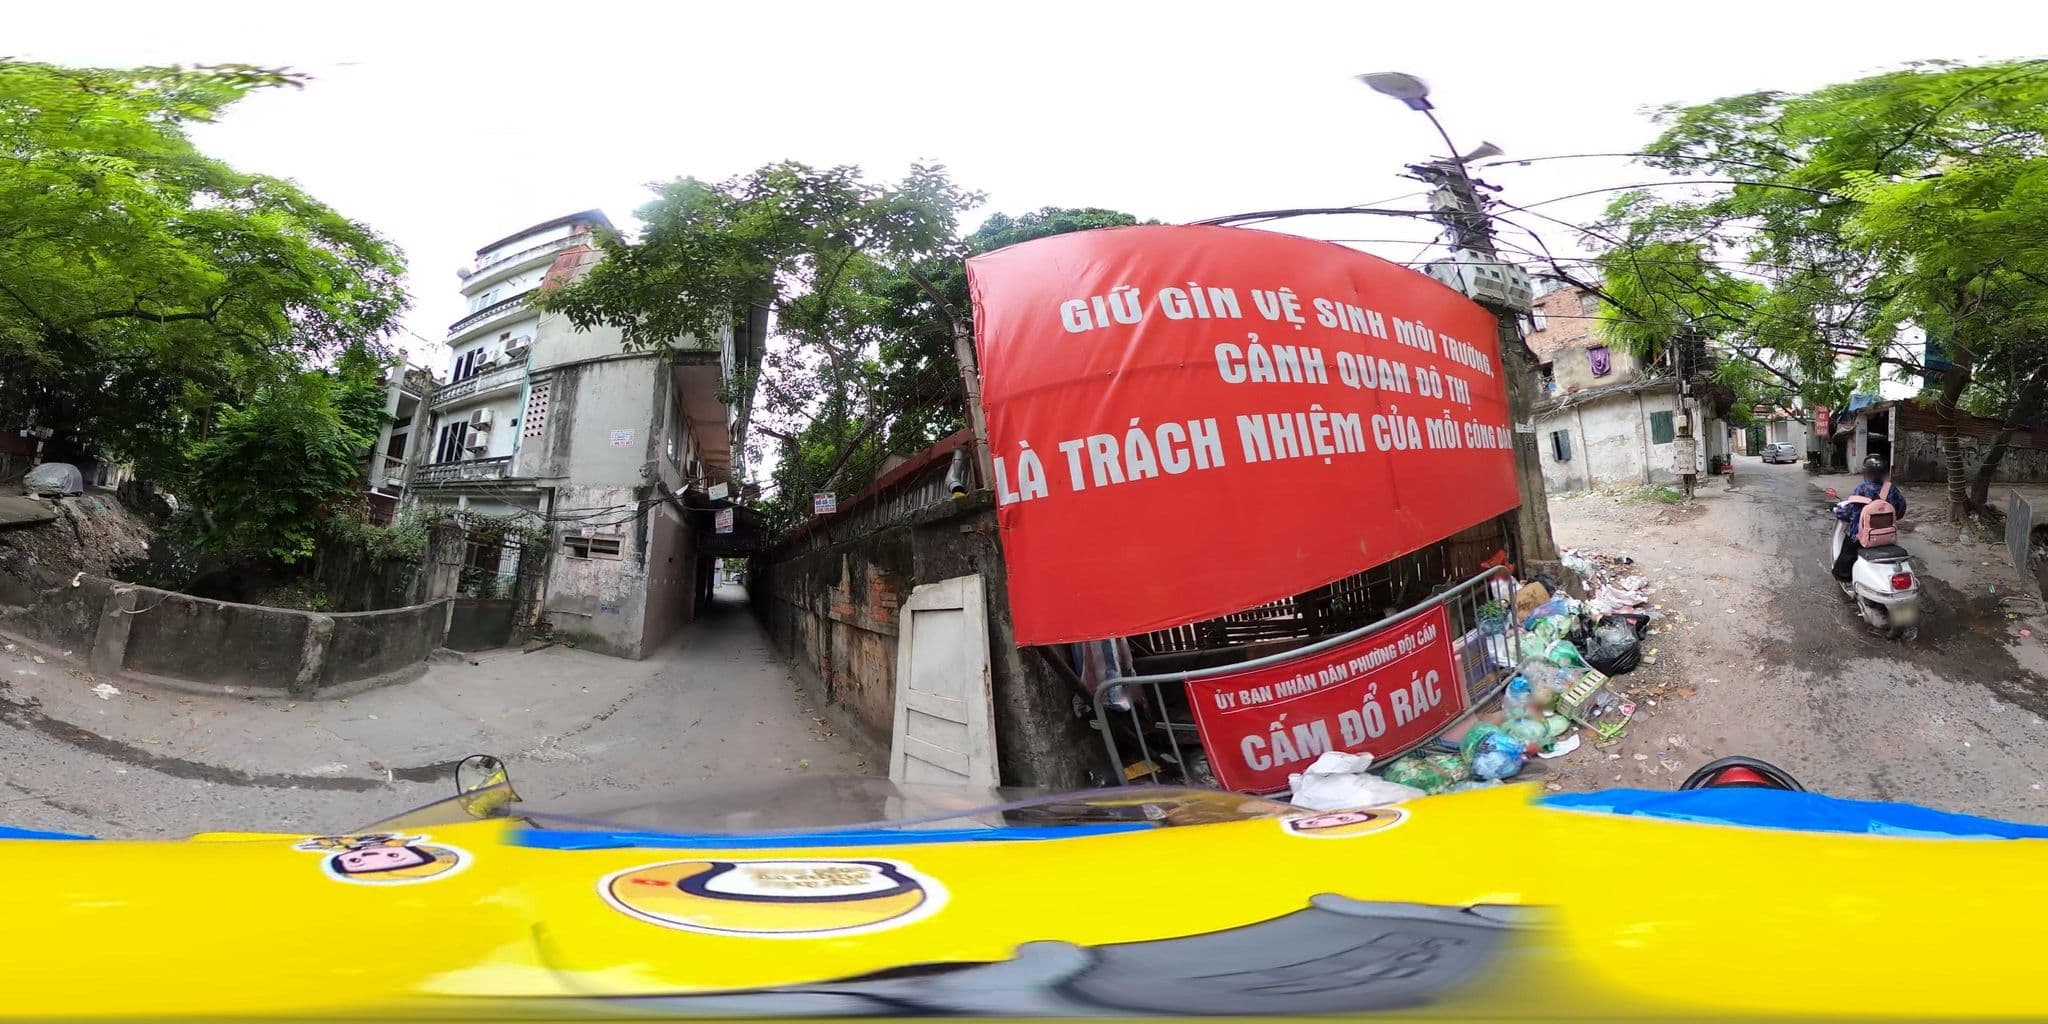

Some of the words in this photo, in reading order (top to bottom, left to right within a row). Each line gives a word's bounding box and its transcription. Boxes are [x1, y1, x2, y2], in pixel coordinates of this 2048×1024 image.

[1060, 284, 1143, 334] GIỮ
[1158, 281, 1243, 320] GÌN
[1251, 286, 1305, 331] VỆ
[1313, 297, 1389, 340] SINH
[1392, 316, 1438, 354] MÔI
[1439, 333, 1495, 379] TRƯỜNG,
[1214, 332, 1329, 385] CẢNH
[1336, 350, 1412, 394] QUAN
[1415, 364, 1443, 400] ĐÔ
[1445, 374, 1472, 412] THỊ
[993, 439, 1049, 506] LÀ
[1058, 416, 1226, 492] TRÁCH
[1236, 403, 1366, 465] NHIỆM
[1371, 404, 1423, 452] CỦA
[1425, 408, 1462, 449] MỖI
[1464, 418, 1496, 449] CÔNG
[1214, 688, 1235, 710] ỦY
[1241, 686, 1272, 705] BAN
[1275, 673, 1317, 697] NHÂN
[1320, 663, 1347, 687] DÂN
[1349, 644, 1397, 675] PHƯỜNG
[1398, 634, 1416, 654] ĐỘI
[1240, 713, 1333, 771] CẤM
[1338, 682, 1386, 747] ĐỔ
[1390, 669, 1442, 727] RÁC
